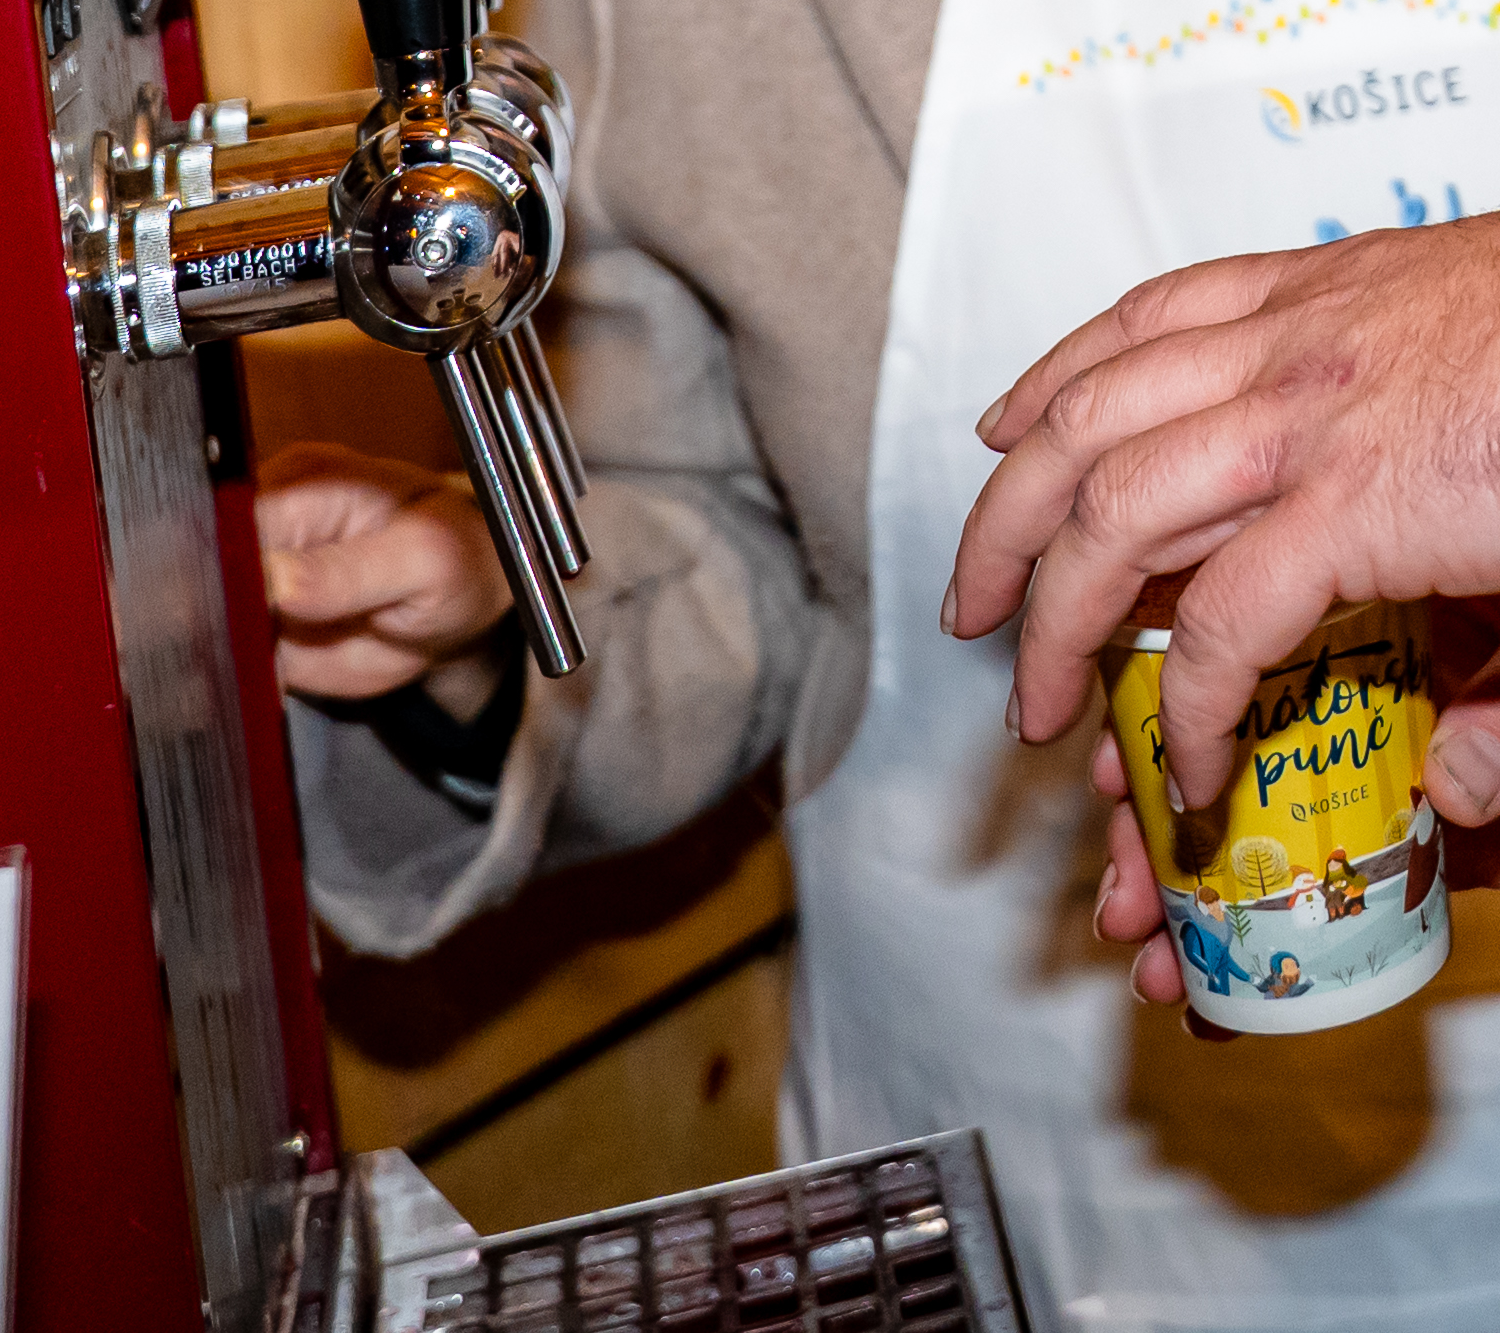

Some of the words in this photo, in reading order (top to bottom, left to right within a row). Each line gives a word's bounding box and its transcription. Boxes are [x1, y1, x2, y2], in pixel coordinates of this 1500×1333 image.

[1306, 67, 1469, 129] KOŠICE
[200, 258, 297, 287] SELBACH
[1255, 704, 1393, 808] punč
[1309, 783, 1370, 817] KOŠICE
